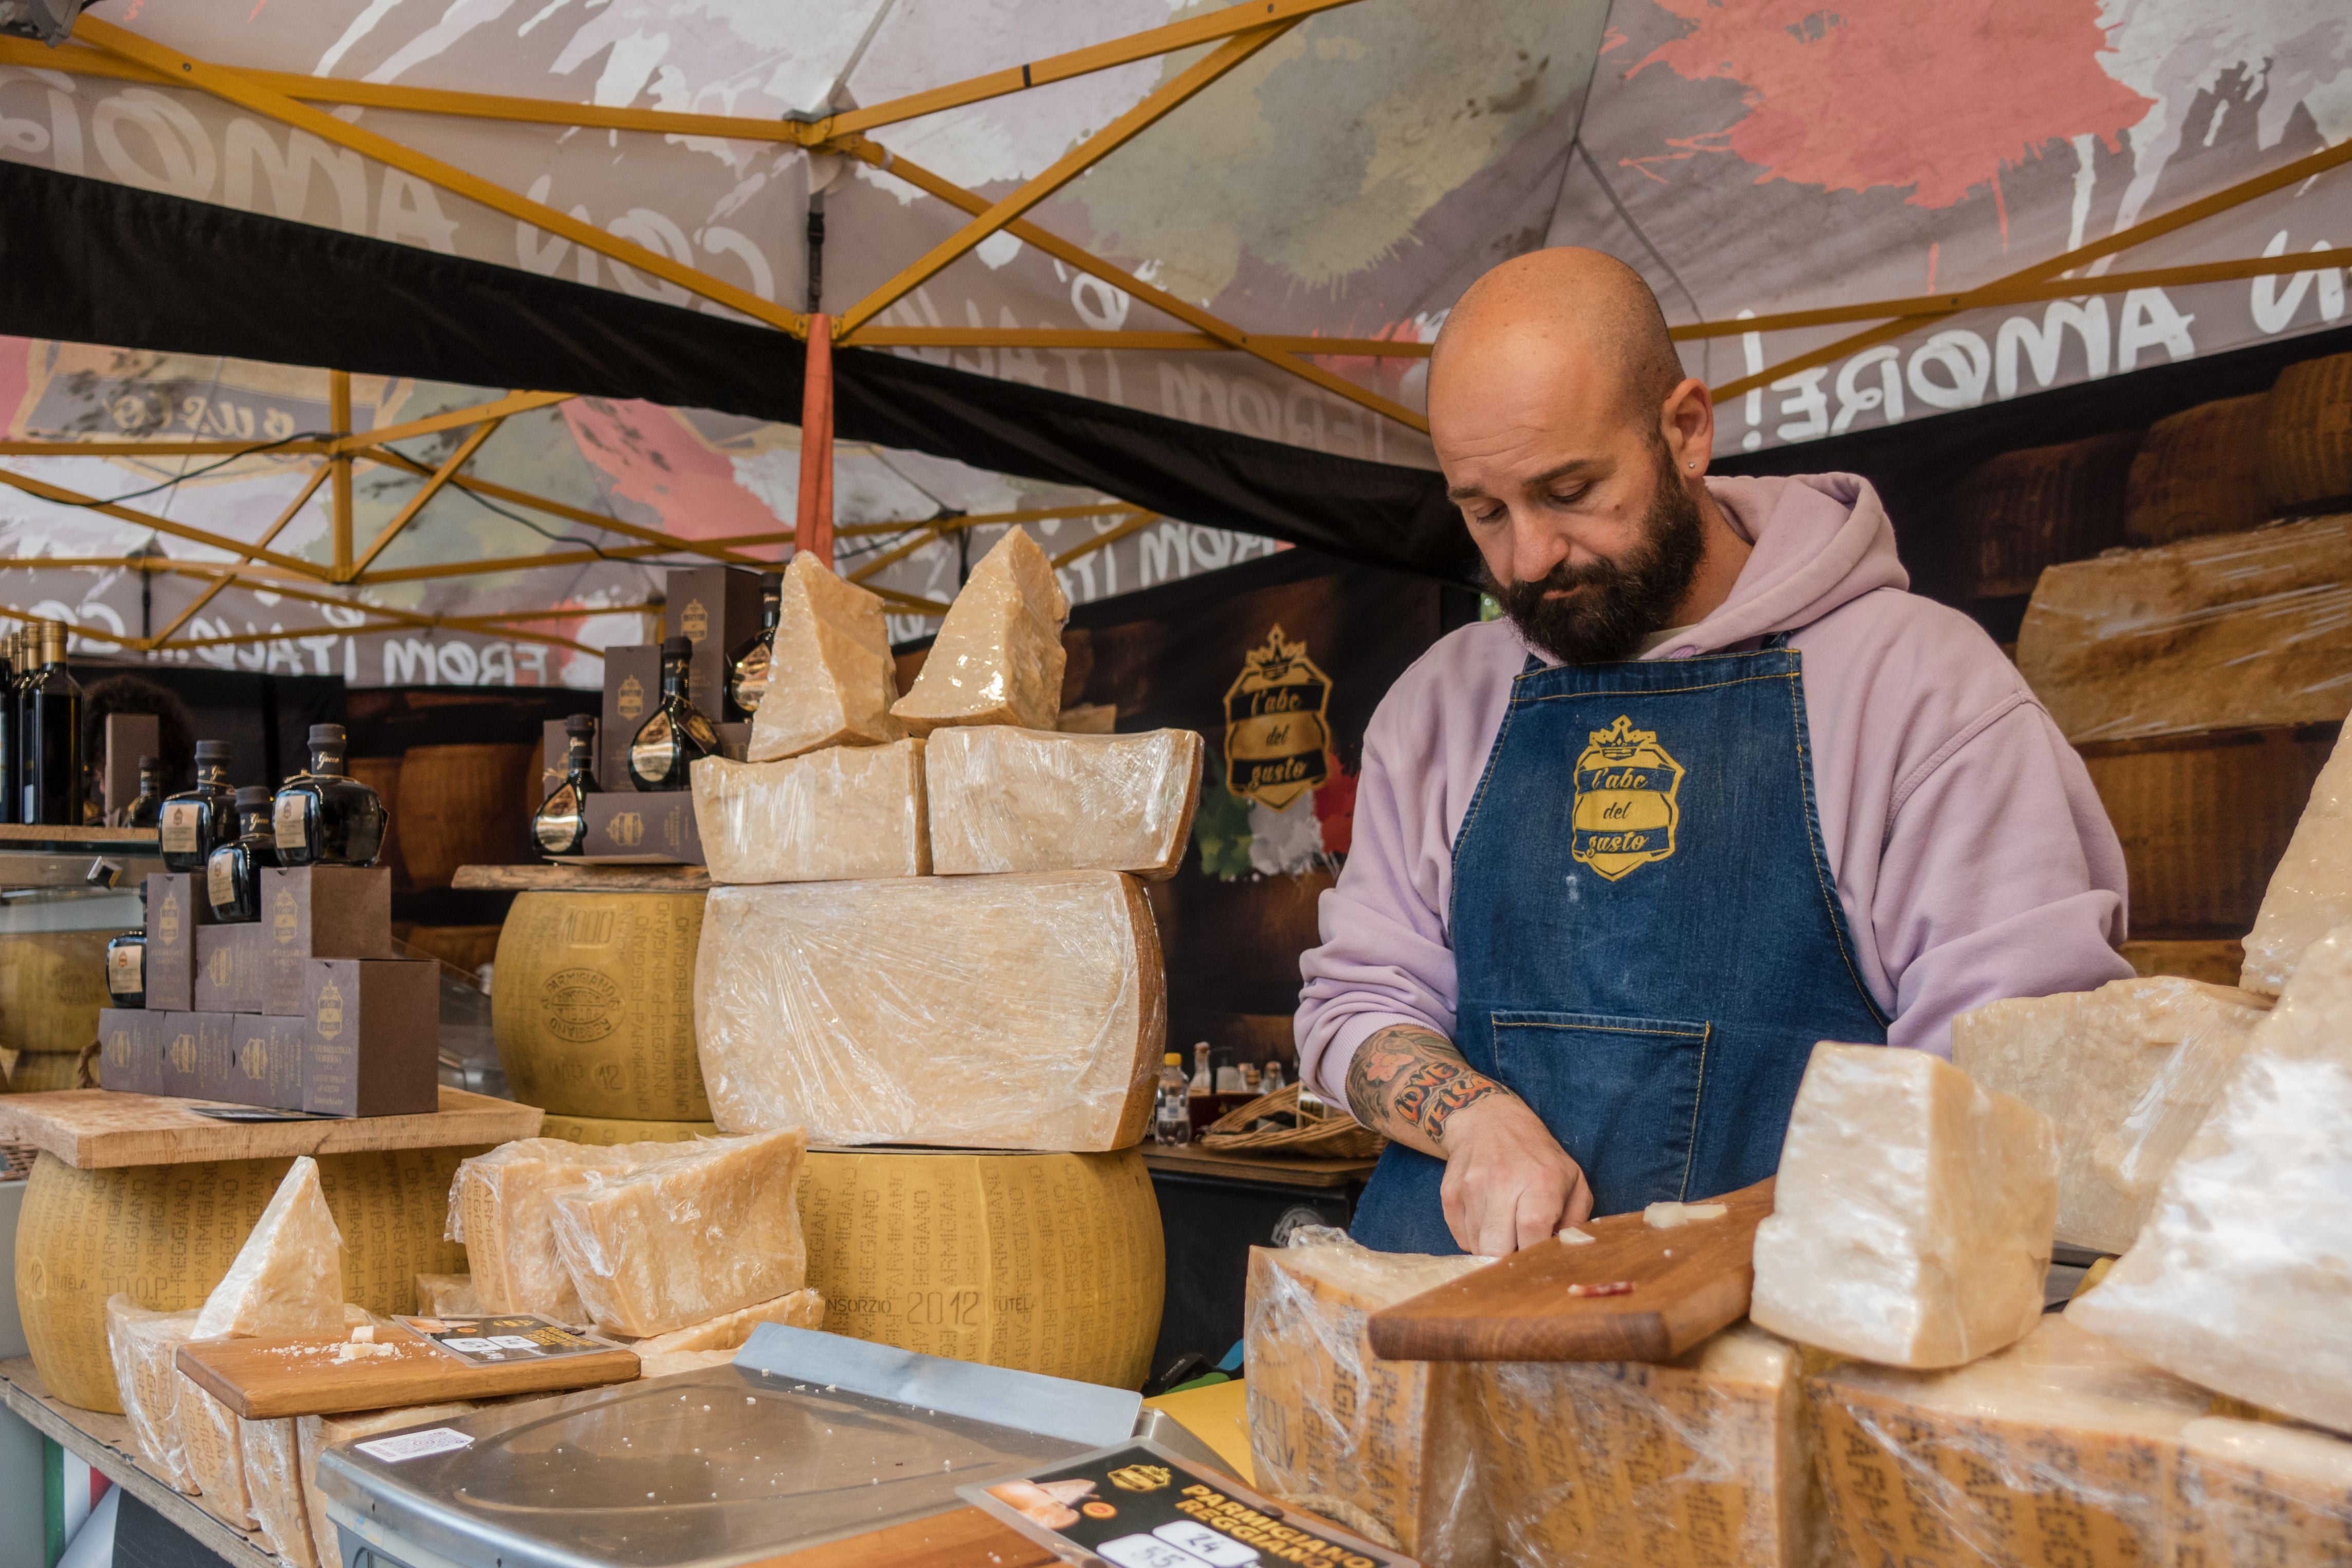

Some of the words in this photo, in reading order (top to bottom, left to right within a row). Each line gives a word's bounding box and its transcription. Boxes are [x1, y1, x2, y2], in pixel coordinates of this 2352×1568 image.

[1266, 725, 1290, 746] del
[1247, 756, 1309, 791] gusto
[1591, 767, 1649, 790] l'abc
[1603, 801, 1633, 820] del
[1585, 831, 1649, 858] gusto
[631, 913, 650, 1001] REGGIANO
[653, 899, 671, 1003] PARMIGIANO
[675, 915, 690, 1002] REGGIANO
[550, 1017, 612, 1040] REGGIANO
[1394, 1062, 1460, 1127] LOVE
[912, 1190, 930, 1286] EGGIANO
[910, 1292, 984, 1327] 2012
[1181, 1483, 1376, 1568] PARMIGIANO
